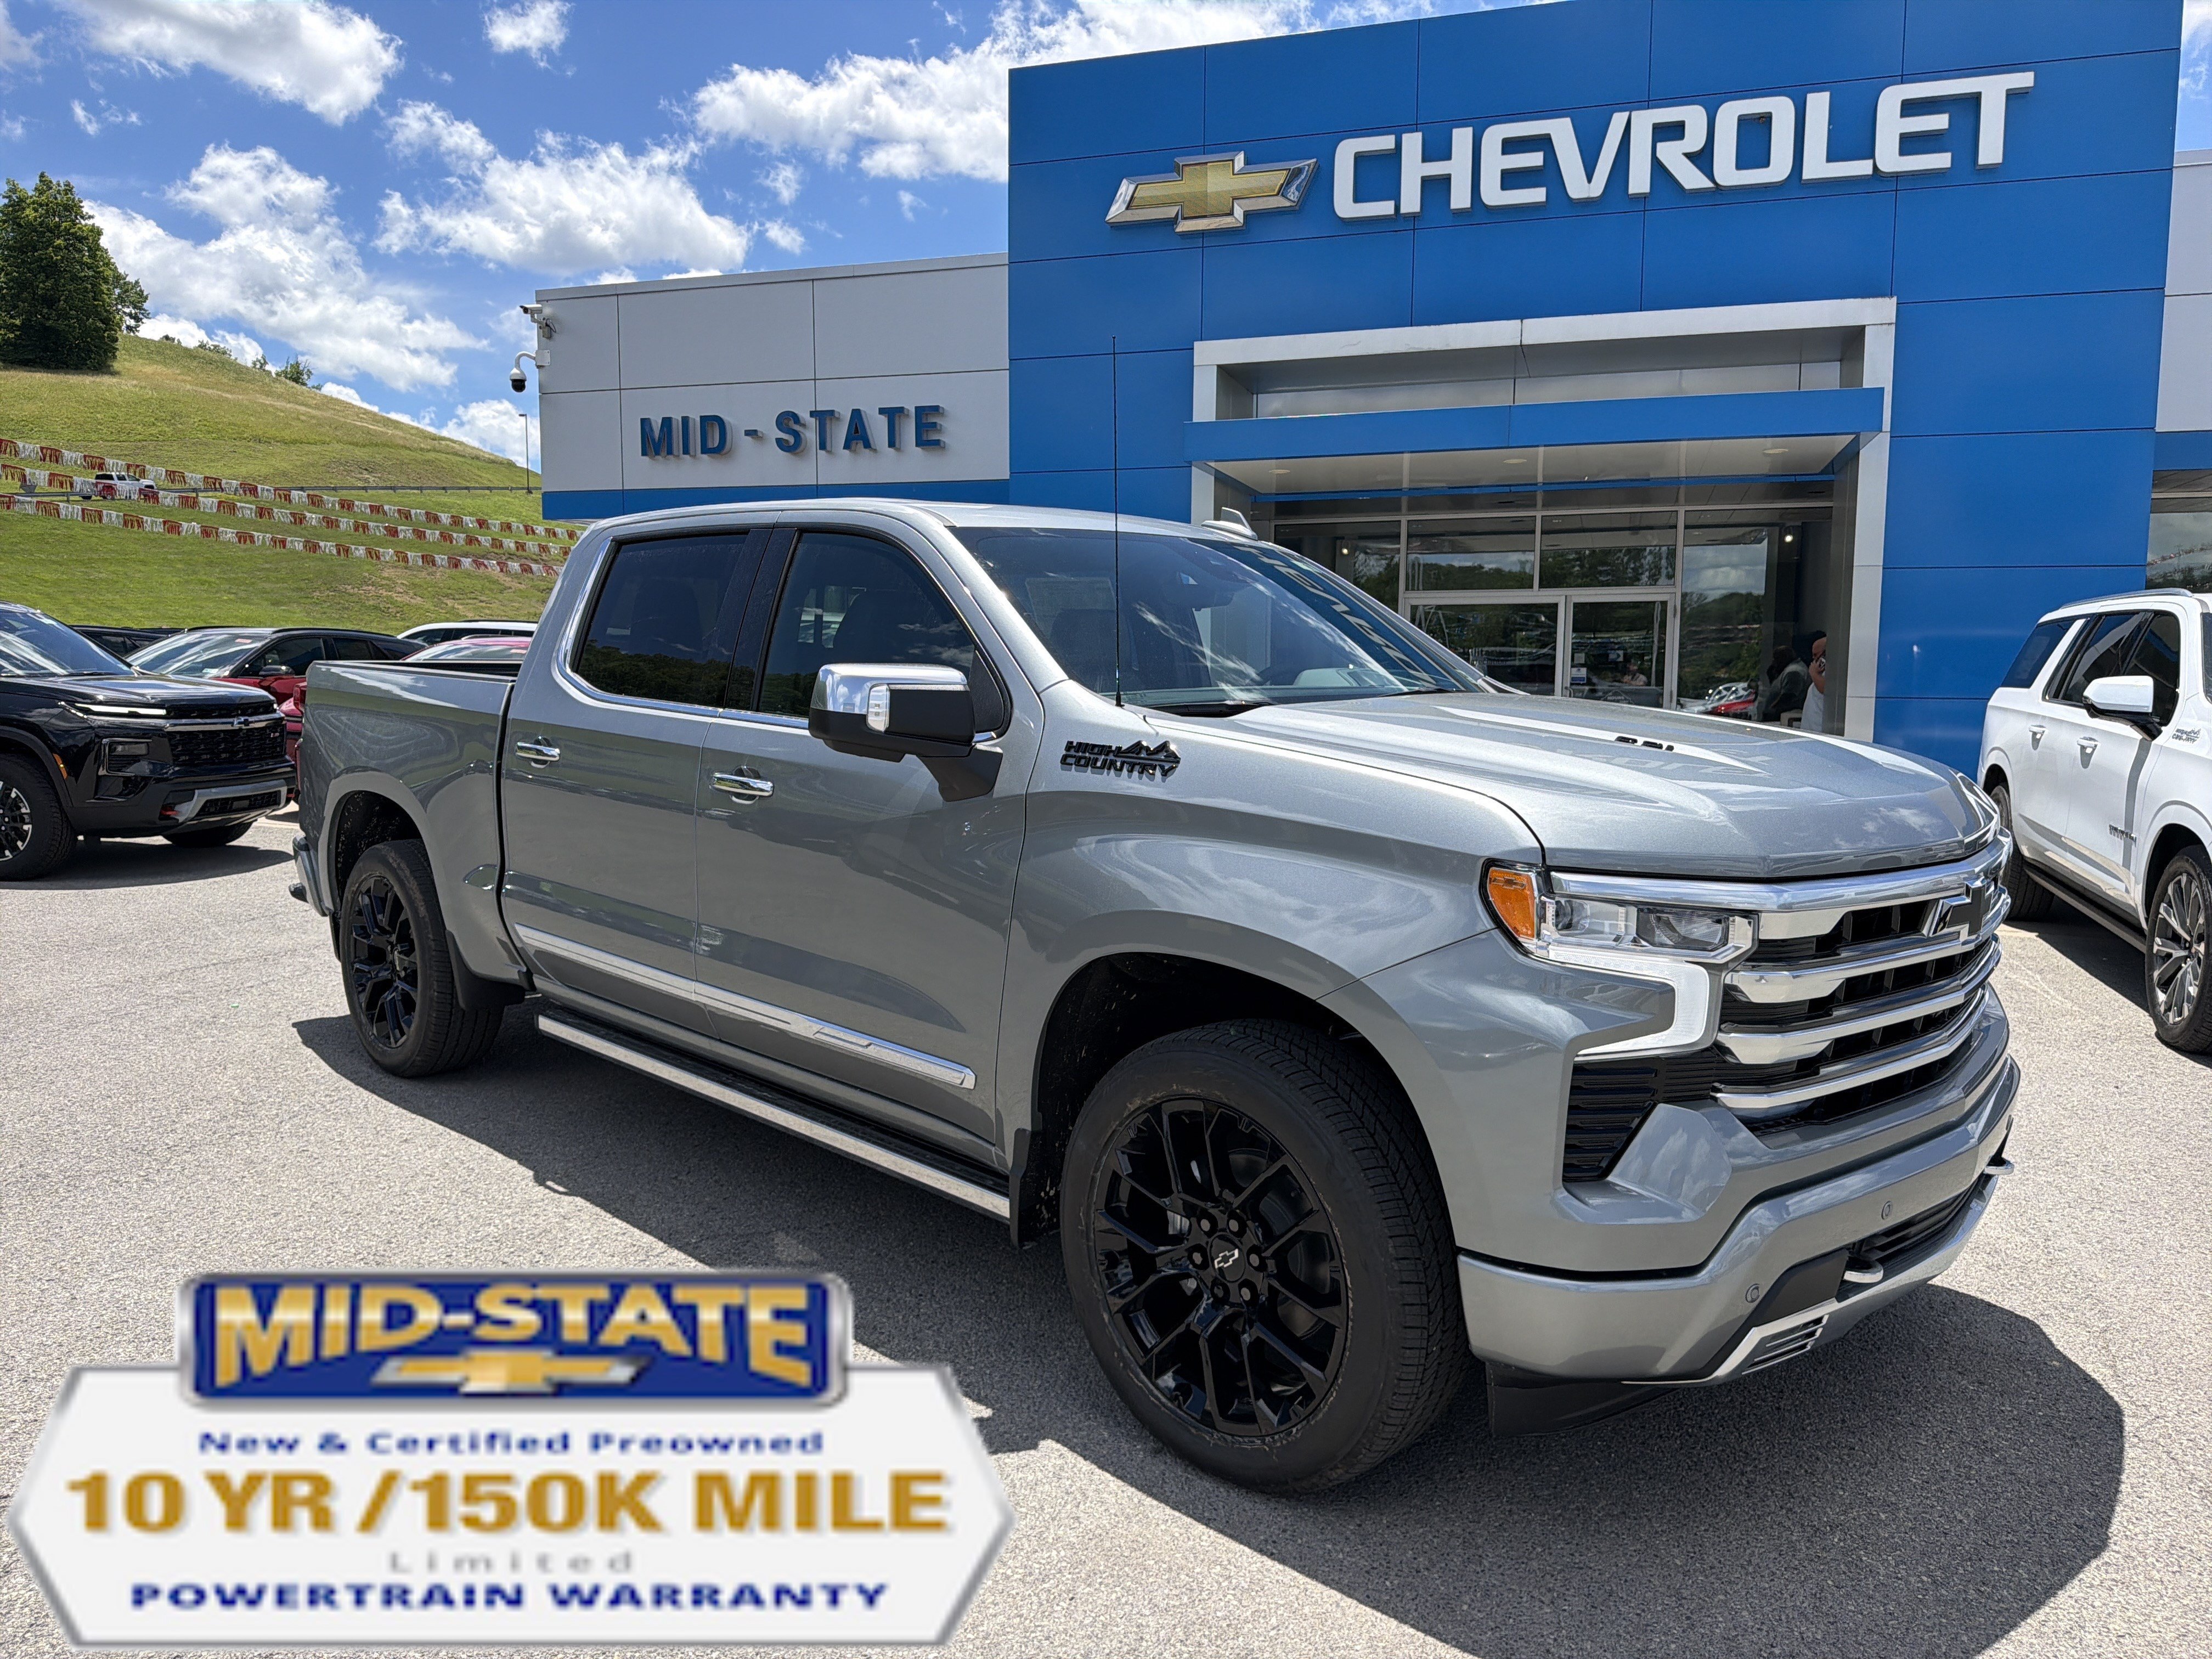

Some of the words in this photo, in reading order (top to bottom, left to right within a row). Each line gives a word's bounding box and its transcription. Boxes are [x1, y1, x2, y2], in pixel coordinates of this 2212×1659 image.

[1333, 71, 2035, 219] CHEVROLET
[1064, 740, 1122, 757] HIGH
[1059, 753, 1180, 777] COUNTRY
